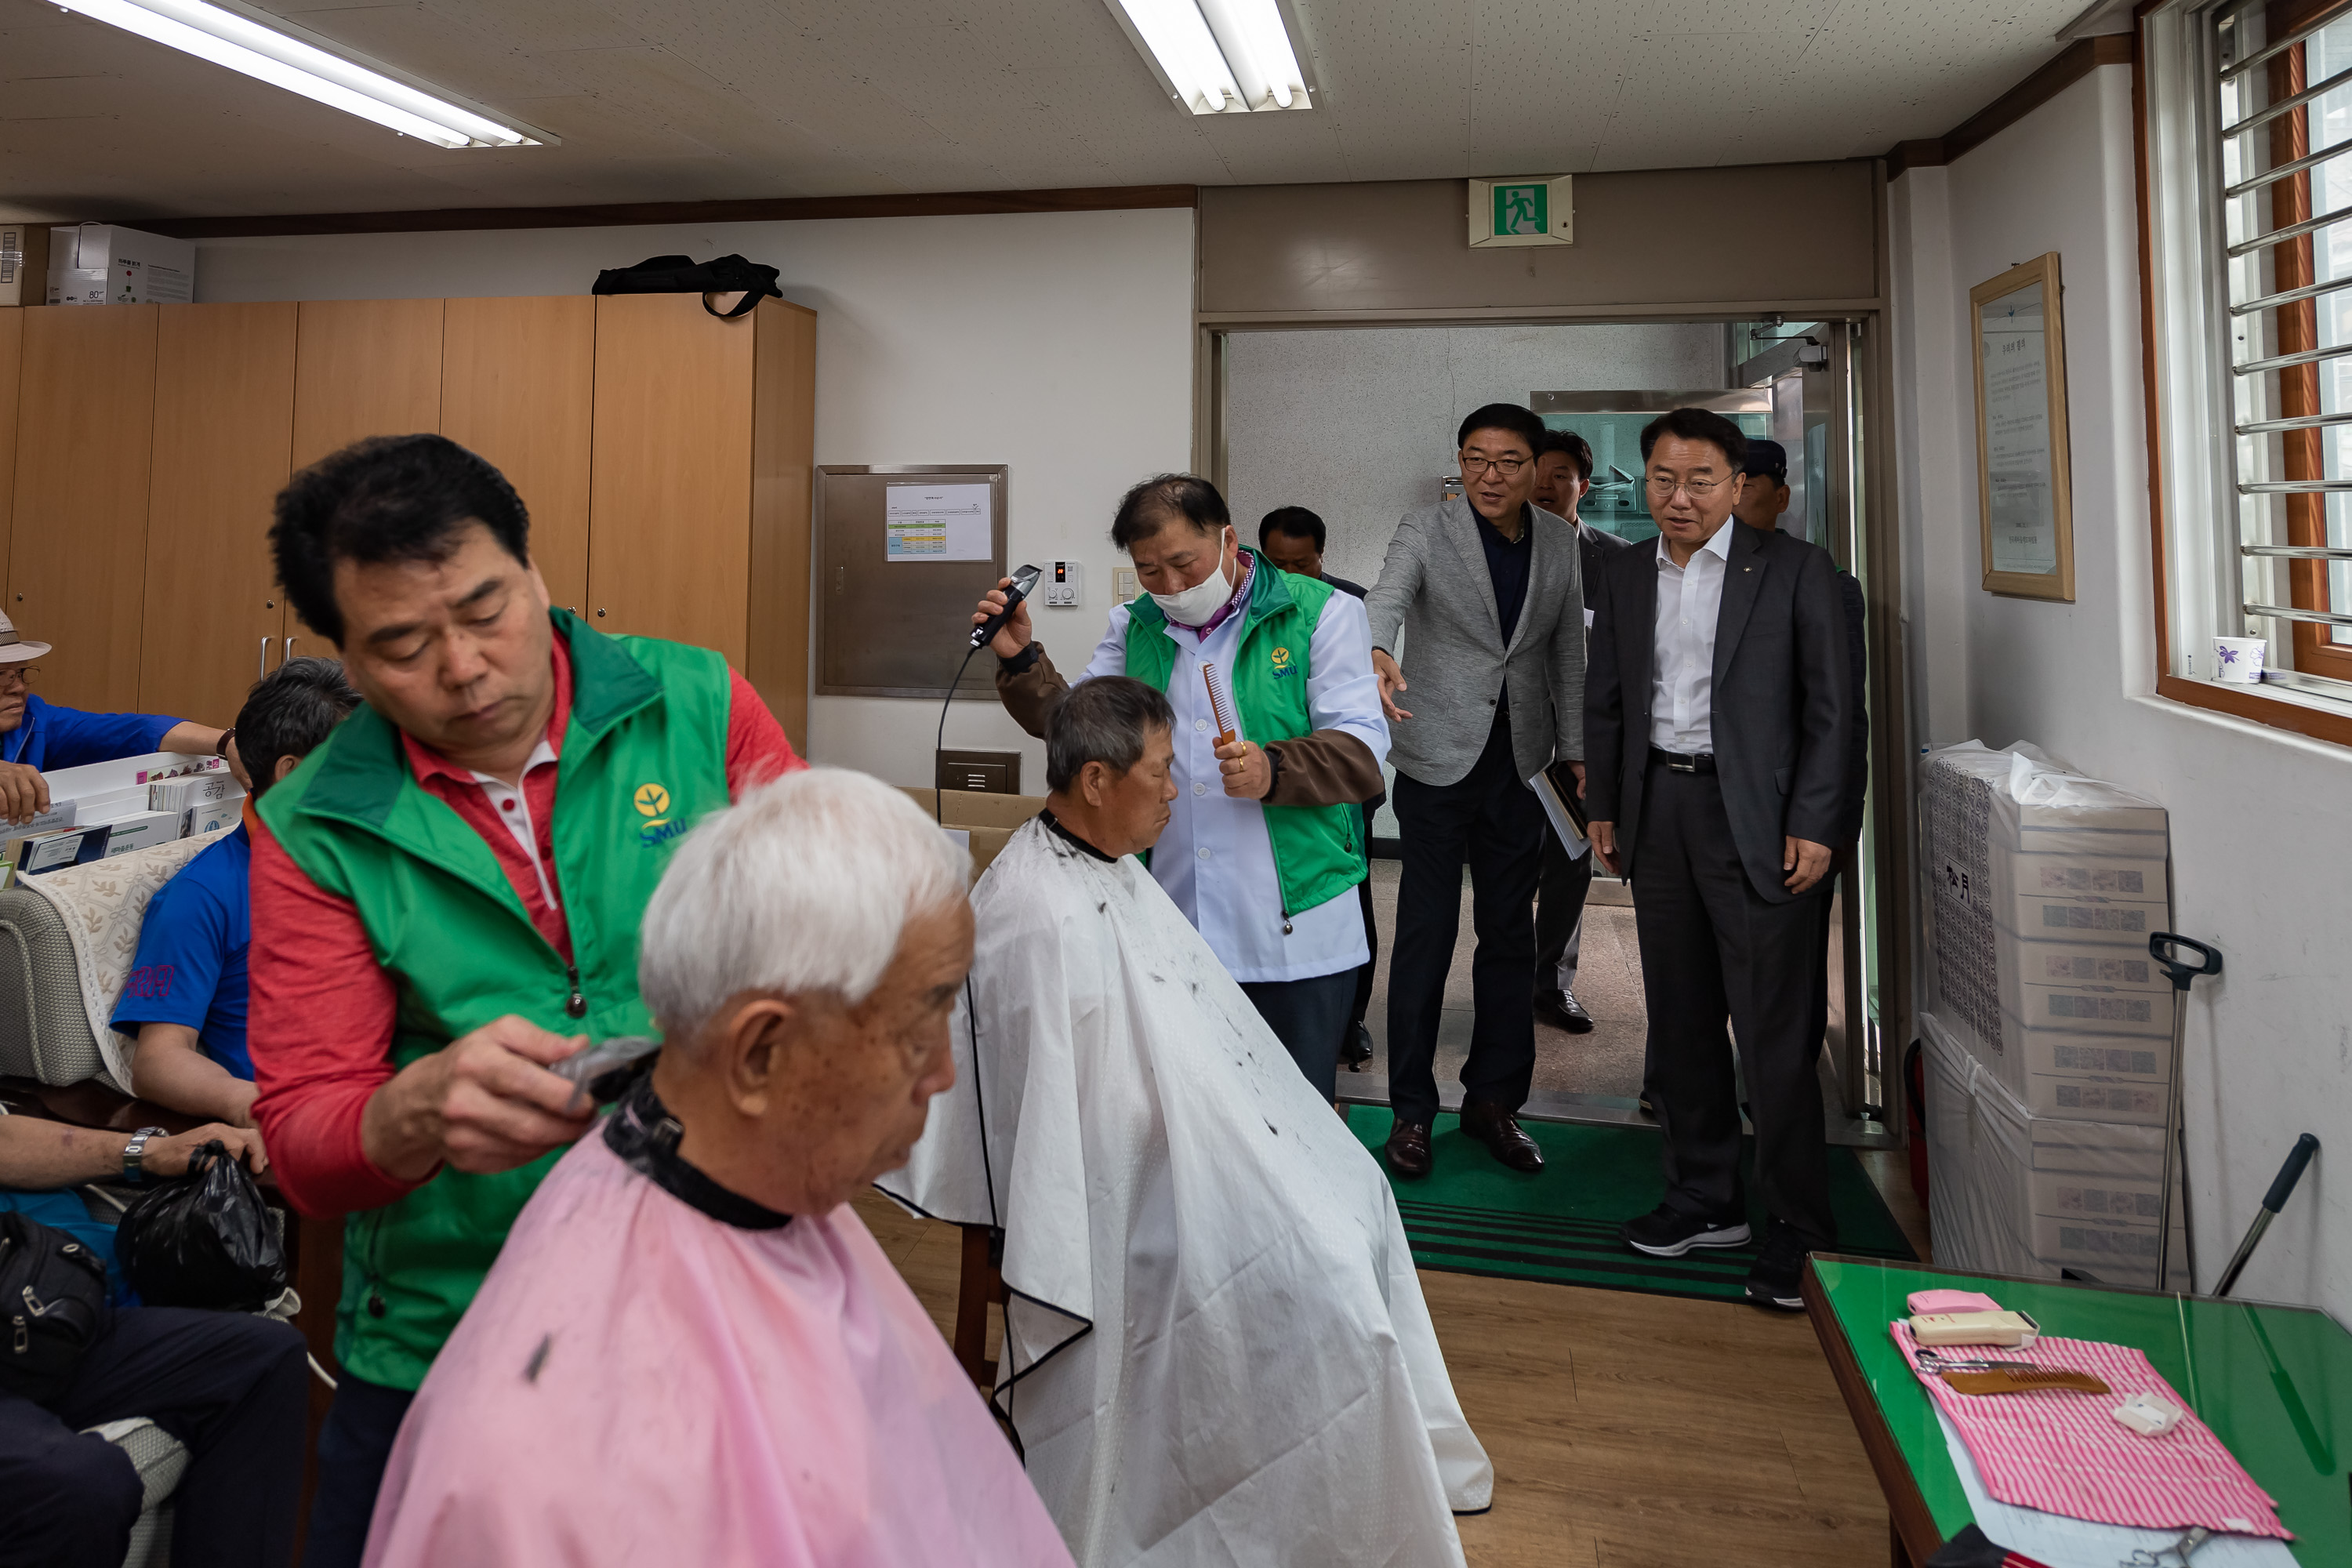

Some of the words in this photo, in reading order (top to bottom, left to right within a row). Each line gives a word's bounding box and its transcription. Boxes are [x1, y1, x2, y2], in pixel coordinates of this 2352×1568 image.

[1272, 666, 1298, 680] SMU
[202, 780, 226, 800] 공감
[640, 818, 688, 848] SMU
